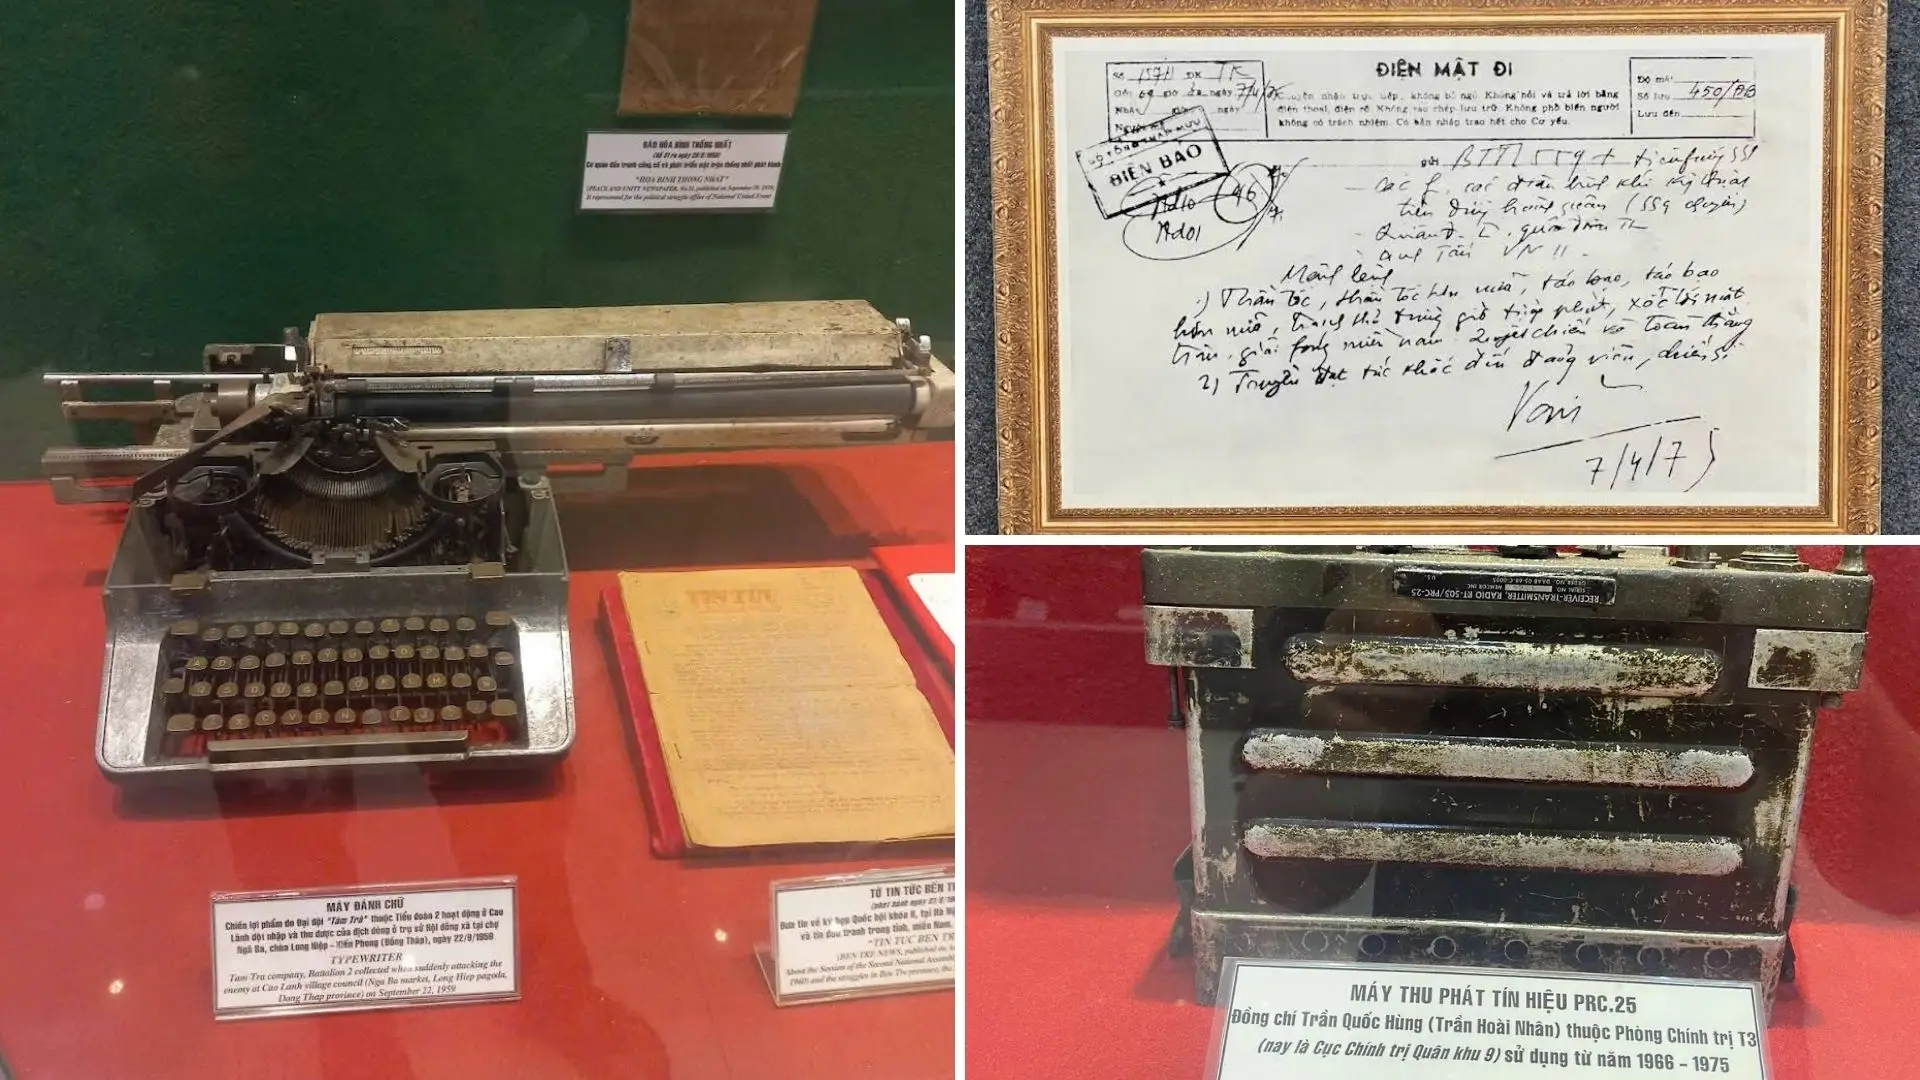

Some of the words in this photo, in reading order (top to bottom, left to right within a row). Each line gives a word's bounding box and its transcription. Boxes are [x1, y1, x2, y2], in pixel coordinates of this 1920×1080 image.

[1376, 58, 1421, 81] ĐIỆN
[1434, 57, 1480, 81] MẬT
[1493, 60, 1512, 77] ĐI
[1510, 117, 1527, 126] cho
[1475, 590, 1503, 600] RADIO
[326, 901, 350, 913] MÁY
[434, 911, 440, 919] 2
[489, 907, 504, 917] Cao
[290, 942, 309, 953] Long
[330, 952, 404, 965] TYPEWRITER
[451, 961, 489, 972] attacking
[490, 959, 503, 968] the
[252, 985, 260, 993] at
[280, 982, 302, 992] Lanh
[304, 981, 331, 991] village
[333, 979, 363, 989] council
[433, 974, 454, 985] Long
[278, 994, 302, 1004] Dong
[303, 992, 325, 1003] Thap
[326, 991, 364, 1002] province)
[379, 988, 420, 999] September
[1350, 981, 1393, 1002] MÁY
[1399, 985, 1433, 1004] THU
[1439, 984, 1486, 1008] PHÁT
[1492, 986, 1520, 1009] TÍN
[1525, 989, 1568, 1014] HIỆU
[1574, 994, 1638, 1014] PRC.25
[1231, 1006, 1270, 1028] Đồng
[1273, 1009, 1299, 1027] chí
[1302, 1010, 1338, 1029] Trần
[1342, 1011, 1381, 1032] Quốc
[1384, 1013, 1423, 1034] Hùng
[1427, 1014, 1473, 1034] (Trần
[1476, 1018, 1511, 1036] Hoài
[1515, 1019, 1561, 1040] Nhân)
[1566, 1023, 1611, 1043] thuộc
[1615, 1024, 1664, 1045] Phòng
[1667, 1027, 1709, 1046] Chính
[1713, 1030, 1734, 1050] trị
[1738, 1031, 1757, 1048] T3
[1256, 1037, 1292, 1057] (nay
[1293, 1039, 1309, 1055] là
[1313, 1040, 1342, 1060] Cục
[1345, 1040, 1387, 1058] Chính
[1389, 1043, 1411, 1063] trị
[1412, 1044, 1452, 1062] Quân
[1453, 1045, 1482, 1063] khu
[1483, 1047, 1501, 1065] 9)
[1504, 1045, 1525, 1064] sử
[1529, 1048, 1569, 1069] dụng
[1573, 1049, 1594, 1067] từ
[1597, 1050, 1632, 1069] năm
[1636, 1052, 1675, 1071] 1966
[1691, 1055, 1731, 1074] 1975
